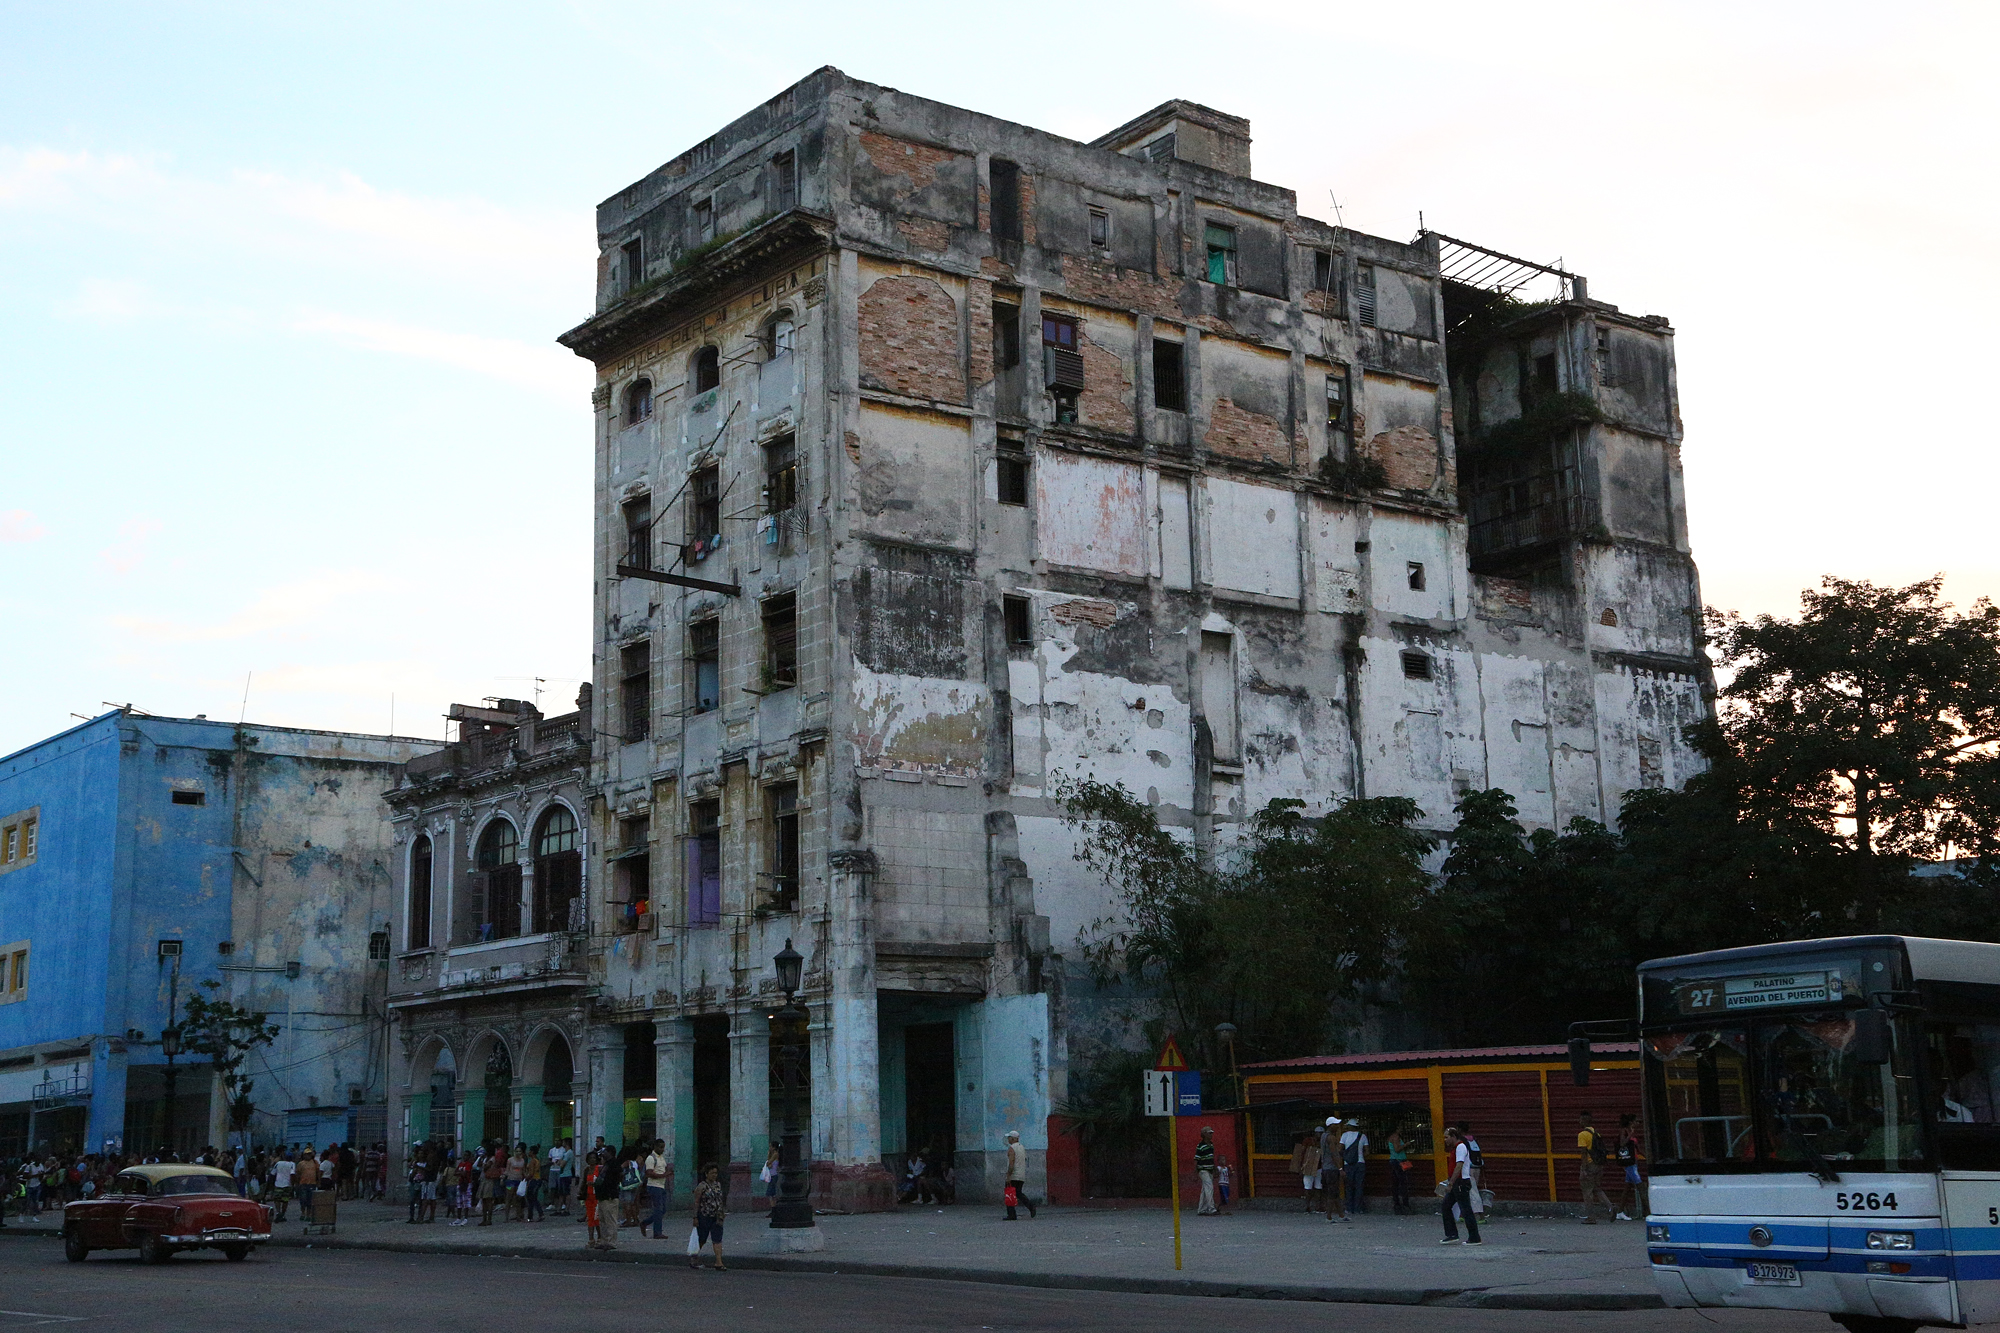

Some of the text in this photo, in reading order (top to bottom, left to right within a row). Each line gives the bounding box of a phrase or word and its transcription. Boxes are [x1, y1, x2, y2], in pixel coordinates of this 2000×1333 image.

[617, 342, 667, 377] HOTEL
[1754, 977, 1795, 988] PALATINO
[1691, 988, 1714, 1007] 27
[1728, 989, 1825, 1006] AVENIDA DEL PUERTO
[1837, 1192, 1898, 1210] 5264
